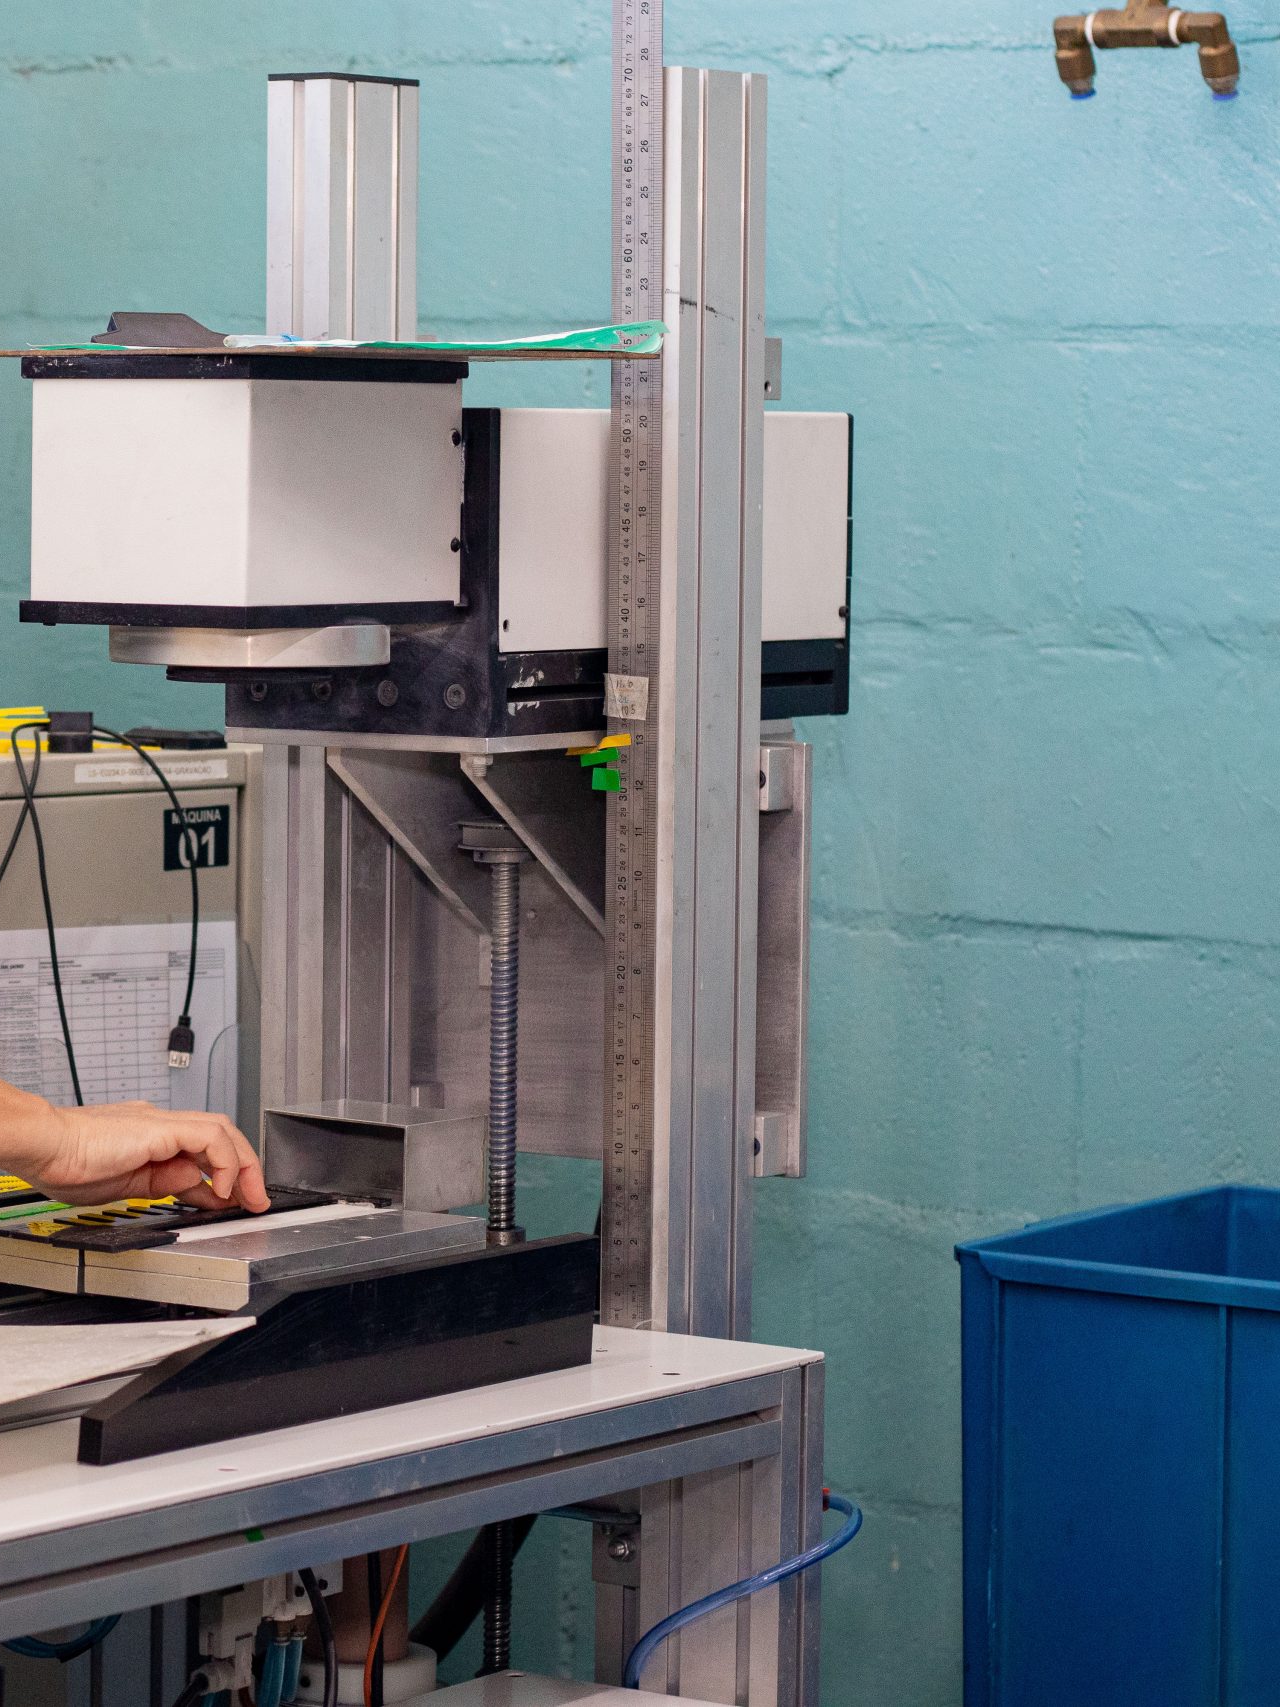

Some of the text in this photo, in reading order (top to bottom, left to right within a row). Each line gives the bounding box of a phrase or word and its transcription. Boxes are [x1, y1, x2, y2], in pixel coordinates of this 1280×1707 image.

[641, 2, 648, 14] 29
[626, 16, 632, 26] 73
[626, 35, 632, 44] 72
[626, 53, 632, 62] 71
[641, 48, 648, 60] 28
[624, 68, 633, 82] 70
[626, 88, 632, 98] 69
[641, 94, 648, 106] 27
[626, 106, 632, 116] 68
[626, 124, 632, 134] 67
[626, 143, 632, 152] 66
[641, 140, 648, 152] 26
[624, 158, 632, 172] 65
[640, 186, 648, 198] 25
[626, 197, 631, 207] 63
[626, 215, 631, 225] 62
[626, 234, 631, 243] 61
[640, 232, 648, 244] 24
[624, 249, 632, 263] 60
[626, 269, 631, 278] 59
[640, 278, 648, 290] 23
[626, 287, 631, 296] 58
[626, 305, 631, 314] 57
[625, 377, 630, 386] 53
[640, 371, 647, 382] 21
[625, 396, 630, 405] 52
[625, 414, 630, 423] 51
[639, 416, 647, 428] 20
[623, 429, 631, 442] 50
[625, 449, 630, 459] 49
[639, 461, 647, 472] 19
[624, 467, 630, 477] 48
[624, 485, 630, 495] 47
[624, 503, 630, 512] 46
[639, 506, 646, 517] 18
[622, 519, 630, 532] 45
[623, 539, 629, 548] 44
[623, 557, 629, 567] 43
[638, 552, 645, 563] 17
[623, 575, 629, 584] 42
[623, 594, 628, 603] 41
[637, 598, 645, 608] 16
[621, 609, 629, 622] 40
[623, 629, 628, 638] 39
[623, 647, 628, 656] 38
[637, 644, 644, 654] 15
[636, 734, 643, 746] 13
[635, 780, 643, 790] 12
[619, 788, 627, 801] 30
[172, 808, 221, 824] MÁQUINA
[620, 808, 626, 817] 29
[620, 826, 626, 835] 28
[635, 827, 642, 837] 11
[179, 826, 215, 868] 01
[620, 843, 626, 852] 27
[620, 861, 625, 870] 26
[634, 870, 642, 881] 10
[618, 876, 626, 890] 25
[619, 897, 624, 905] 24
[619, 915, 624, 924] 23
[619, 932, 624, 942] 22
[619, 951, 624, 960] 21
[617, 966, 625, 979] 20
[616, 1054, 624, 1066] 15
[615, 1143, 623, 1154] 10
